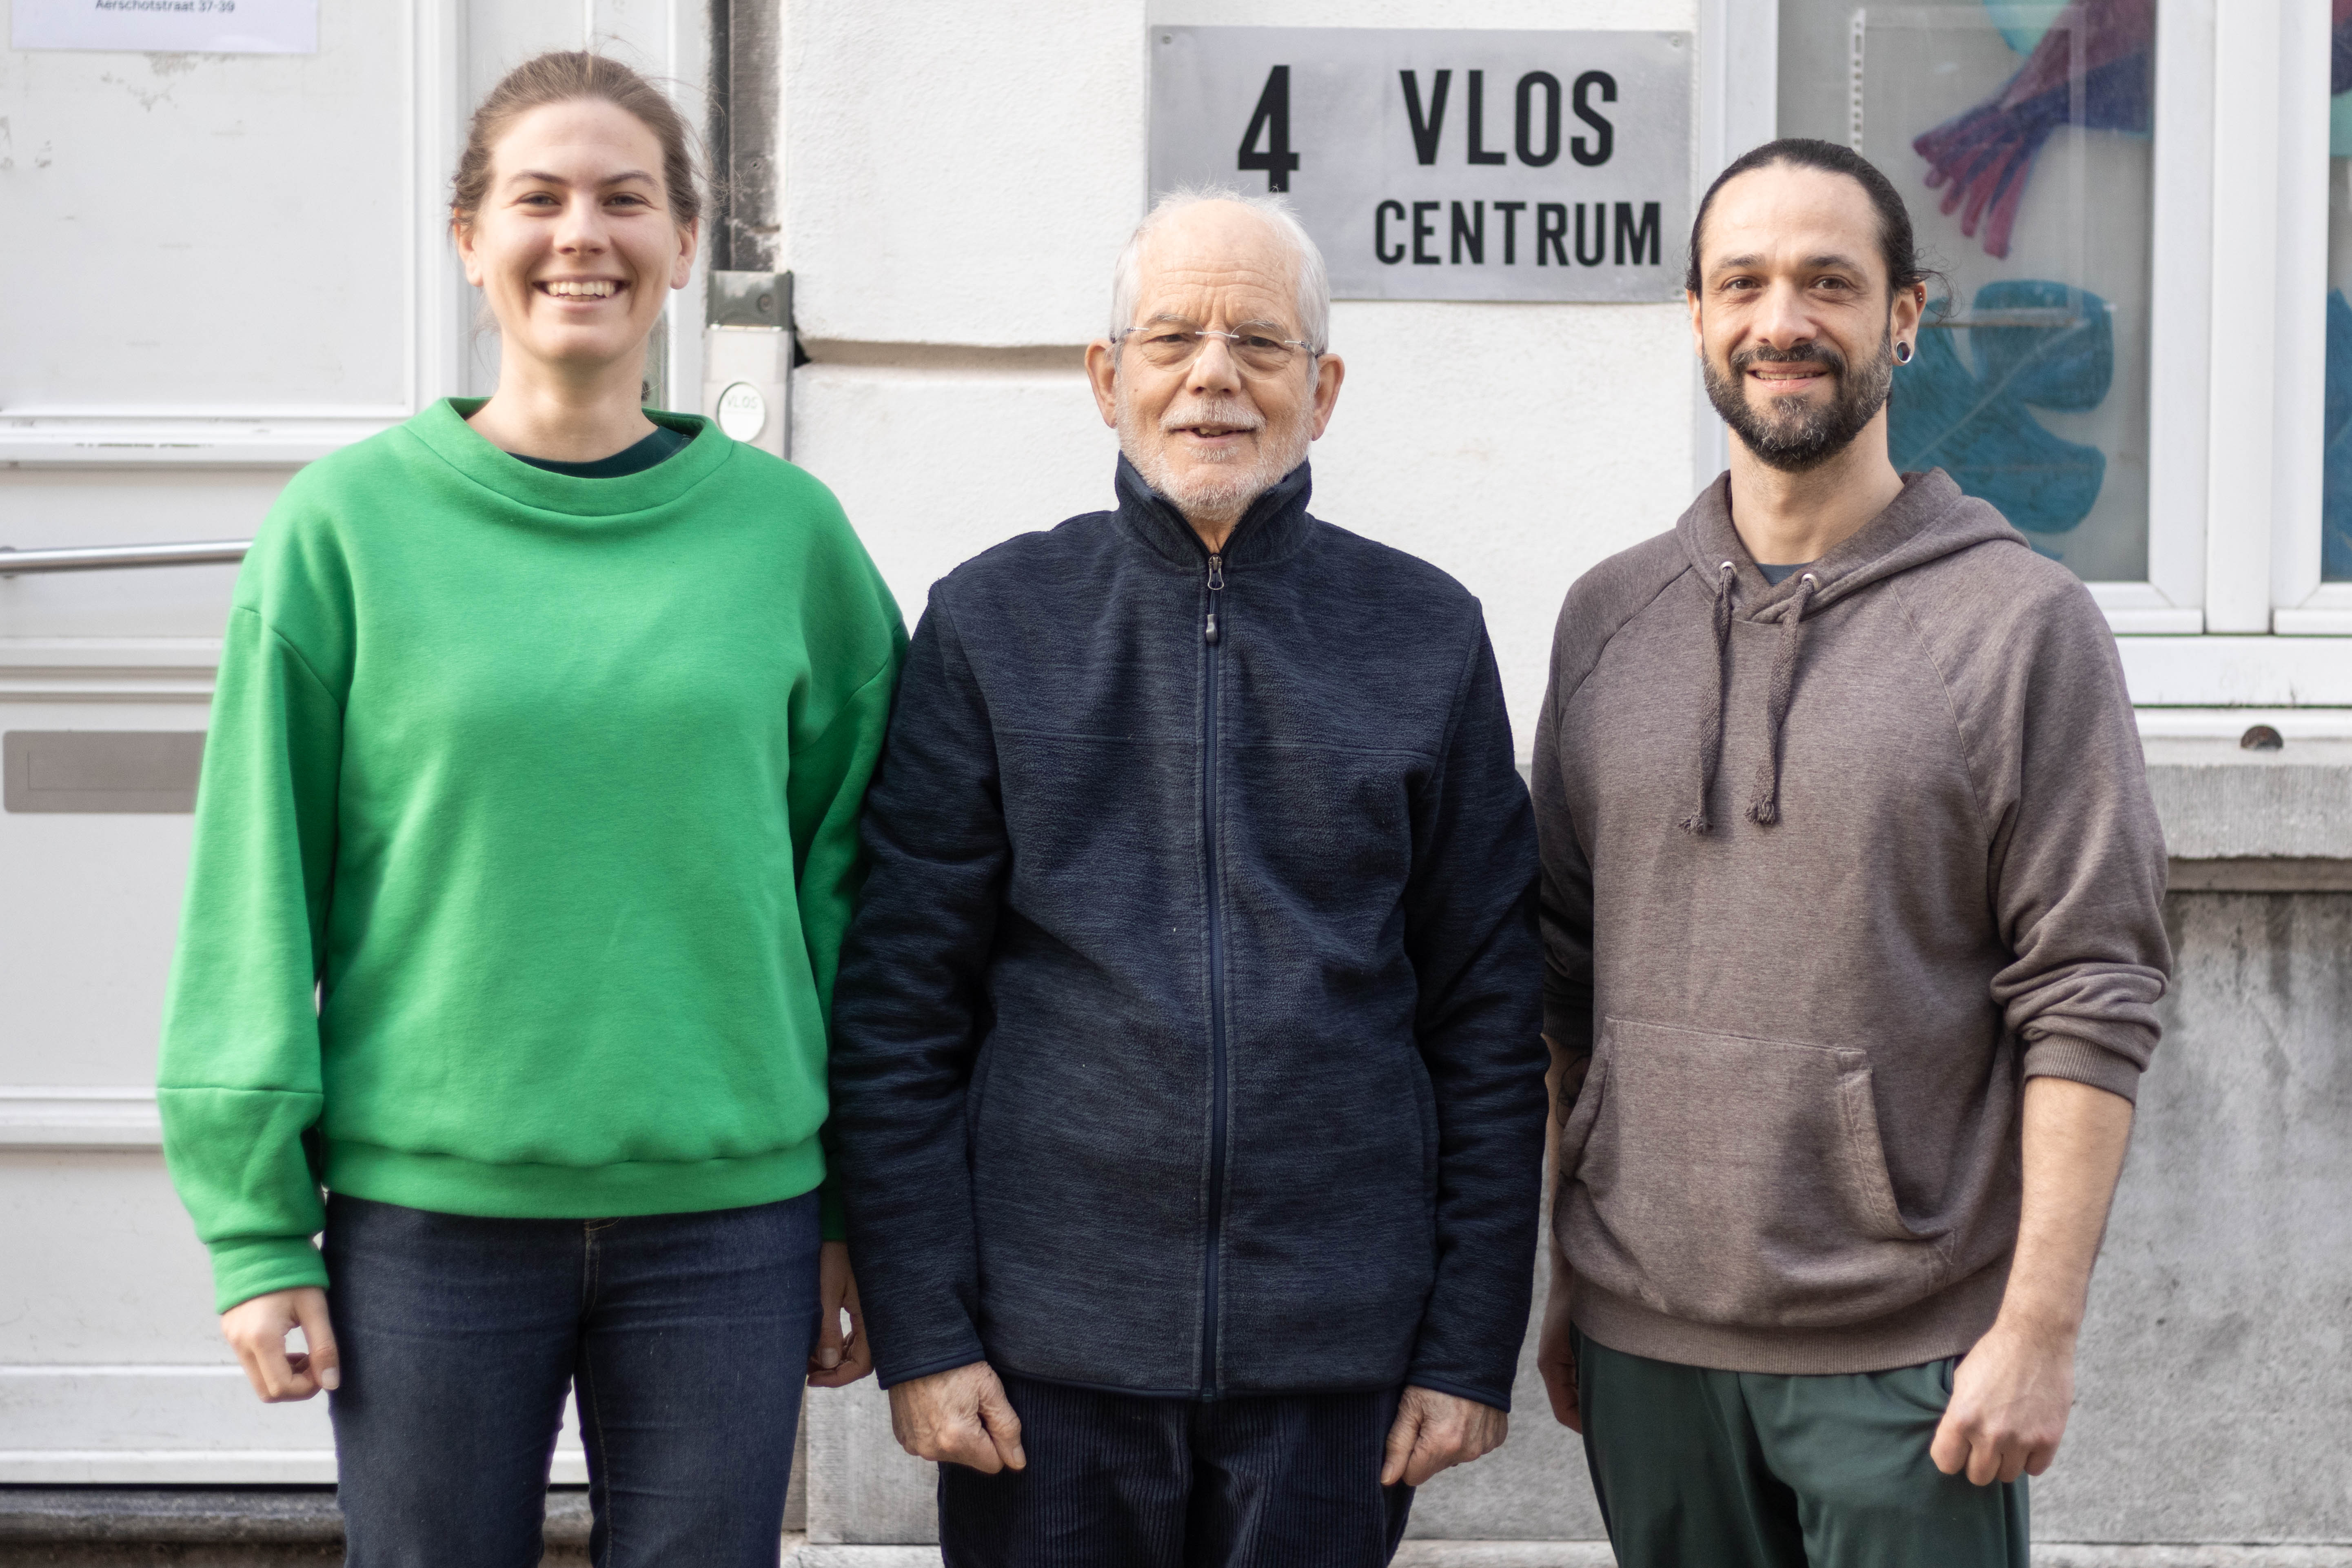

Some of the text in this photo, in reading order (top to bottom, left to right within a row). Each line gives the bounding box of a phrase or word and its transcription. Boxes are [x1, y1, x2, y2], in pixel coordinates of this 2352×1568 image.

[95, 0, 194, 11] Aerschotstraat
[1238, 64, 1617, 193] 4 VLOS
[1375, 200, 1661, 267] CENTRUM
[726, 395, 758, 409] VLOS
